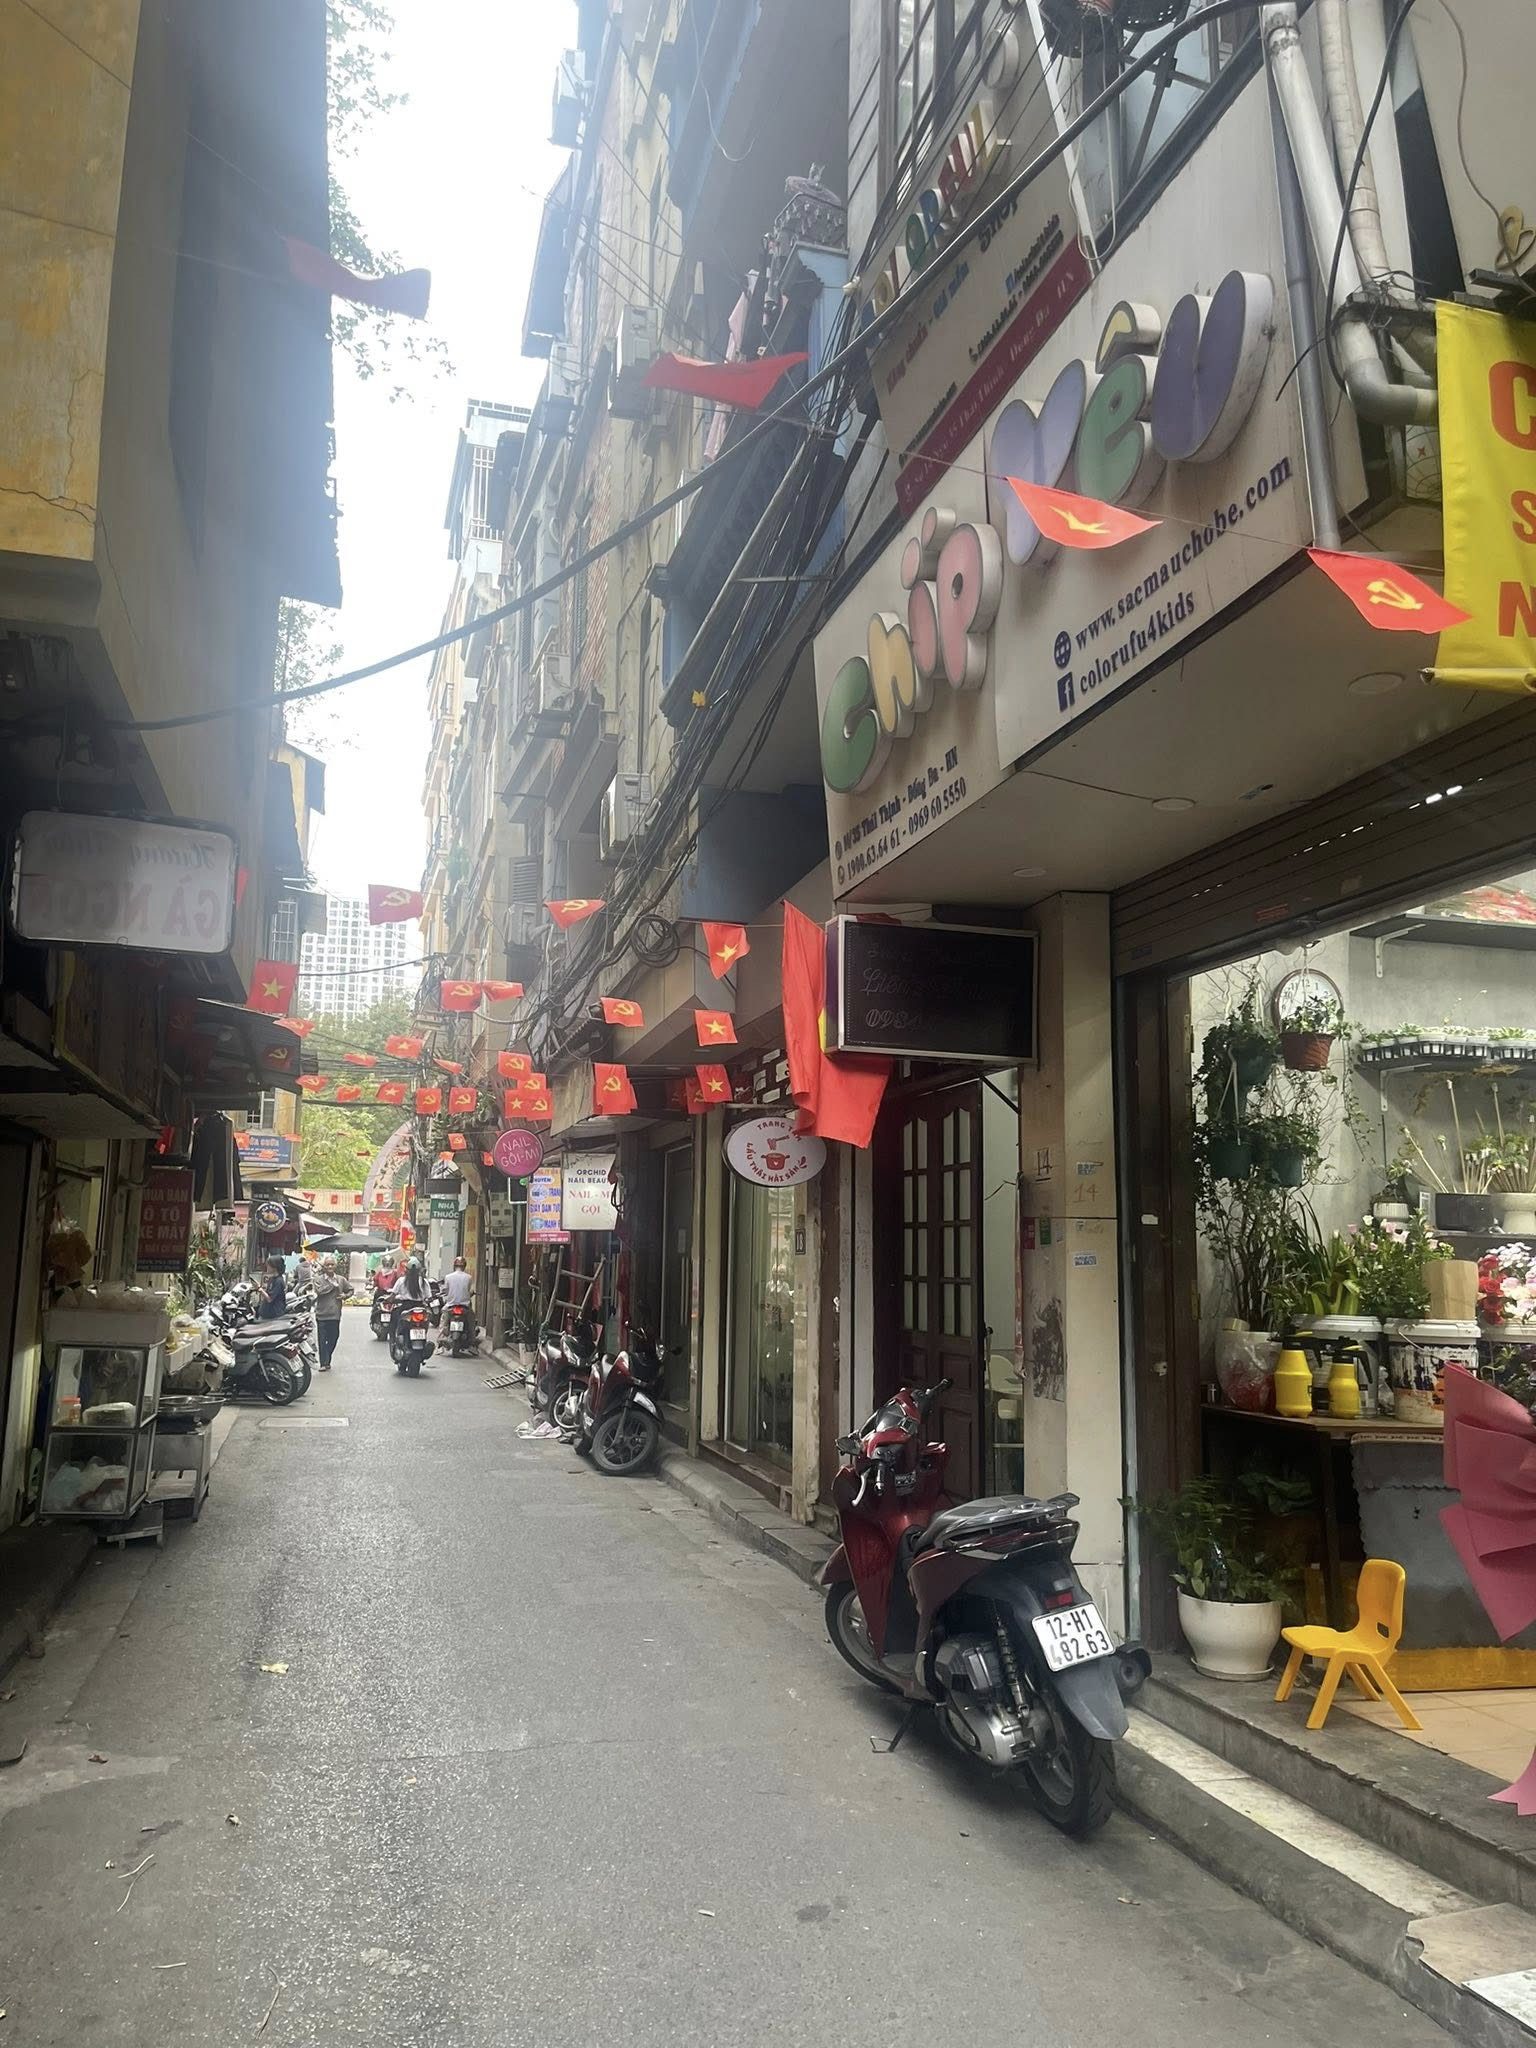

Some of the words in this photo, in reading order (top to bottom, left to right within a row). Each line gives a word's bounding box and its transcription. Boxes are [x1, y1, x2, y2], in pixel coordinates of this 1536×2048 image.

[1075, 457, 1293, 652] www.sacmauchobe.com
[908, 805, 930, 836] 0969
[942, 776, 967, 811] 5550
[757, 1120, 785, 1131] TRANG
[502, 1137, 531, 1153] NAIL
[749, 1161, 768, 1180] THÁI
[569, 1190, 593, 1199] NAIL
[432, 1209, 460, 1219] THUỐC
[1045, 1608, 1093, 1640] 12-H1
